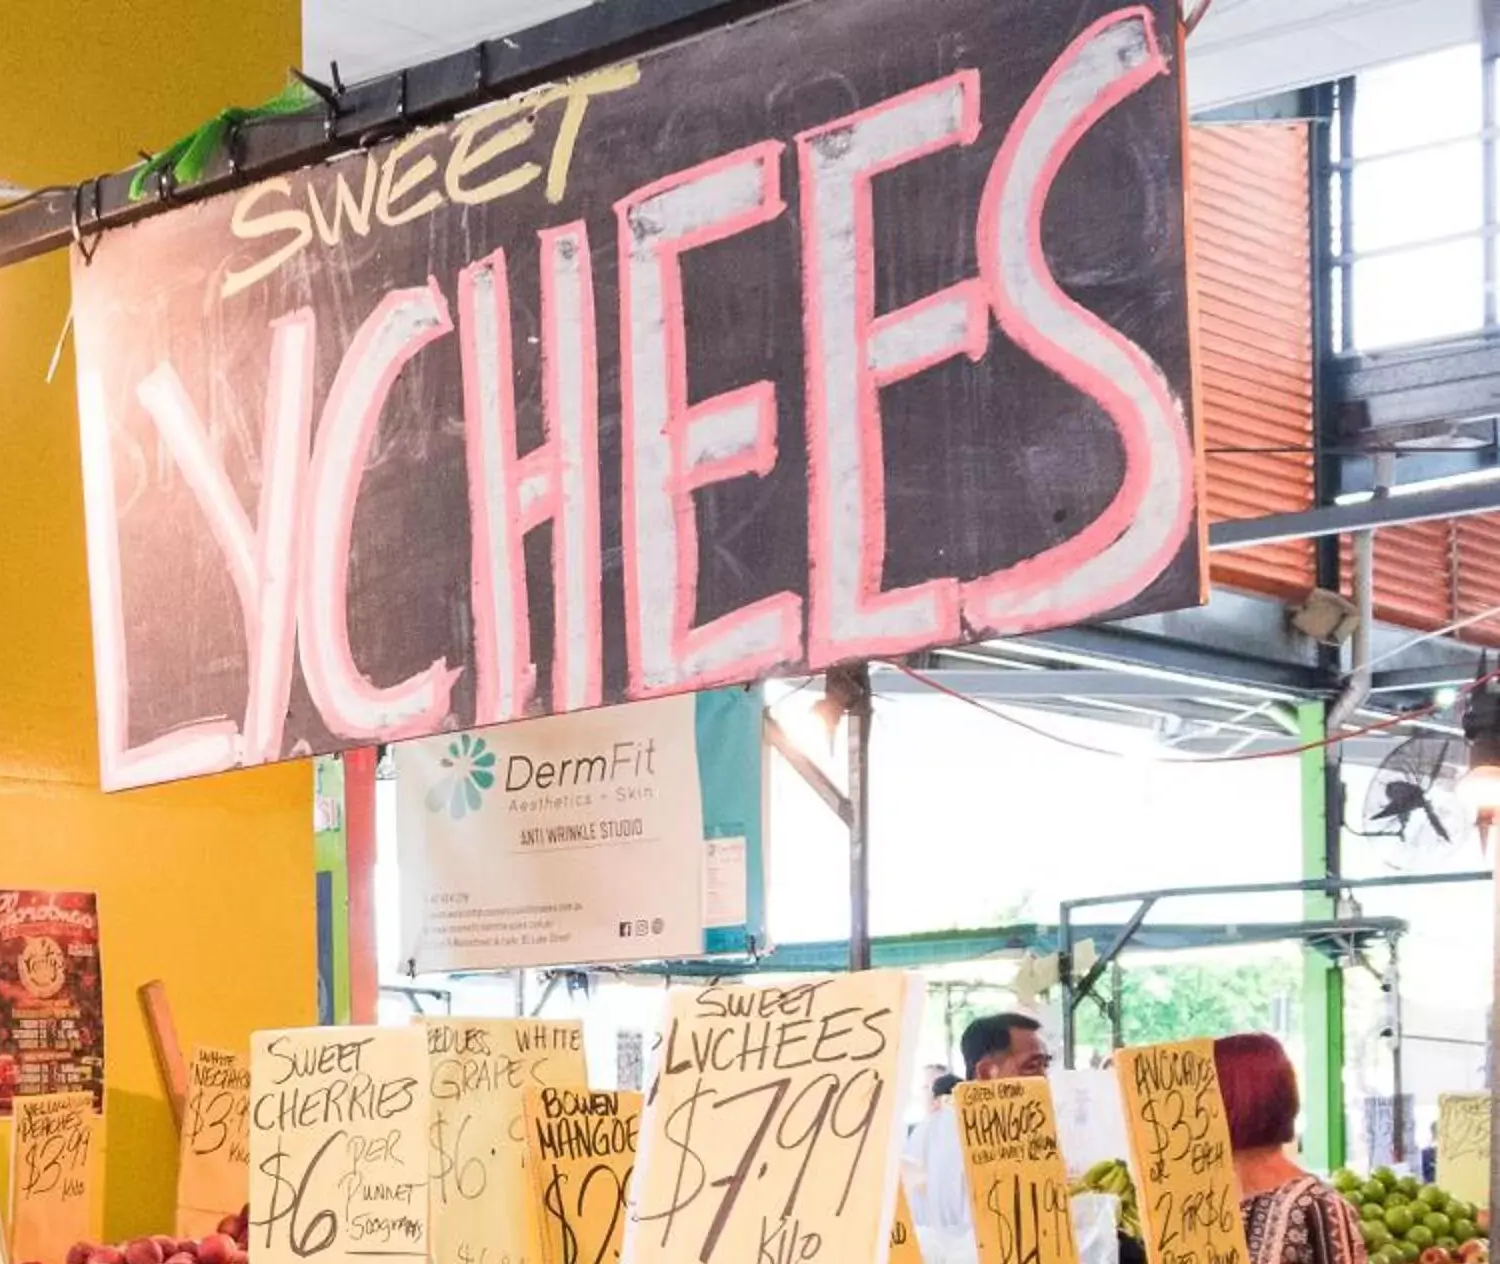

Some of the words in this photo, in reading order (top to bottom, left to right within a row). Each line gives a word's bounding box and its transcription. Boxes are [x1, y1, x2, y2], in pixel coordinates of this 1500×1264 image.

[222, 66, 641, 297] SWEET
[78, 6, 1196, 792] LYCHEES
[505, 738, 656, 793] DermFit
[508, 794, 593, 814] Aesthetics
[615, 786, 654, 803] Skin
[520, 828, 545, 846] ANTI
[546, 823, 596, 844] WRINKLE
[600, 817, 644, 840] STUDIO
[696, 980, 834, 1018] SWEET
[267, 1036, 376, 1085] SWEET
[516, 1027, 582, 1053] WHITE
[665, 1008, 891, 1075] LYCHEES
[253, 1072, 419, 1133] CHERRIES
[541, 1087, 619, 1120] BOWEN
[962, 1099, 1047, 1147] MANGOES
[348, 1129, 405, 1175] PER
[630, 1068, 885, 1264] $7.99
[249, 1129, 348, 1259] $6
[1155, 1190, 1179, 1251] 2
